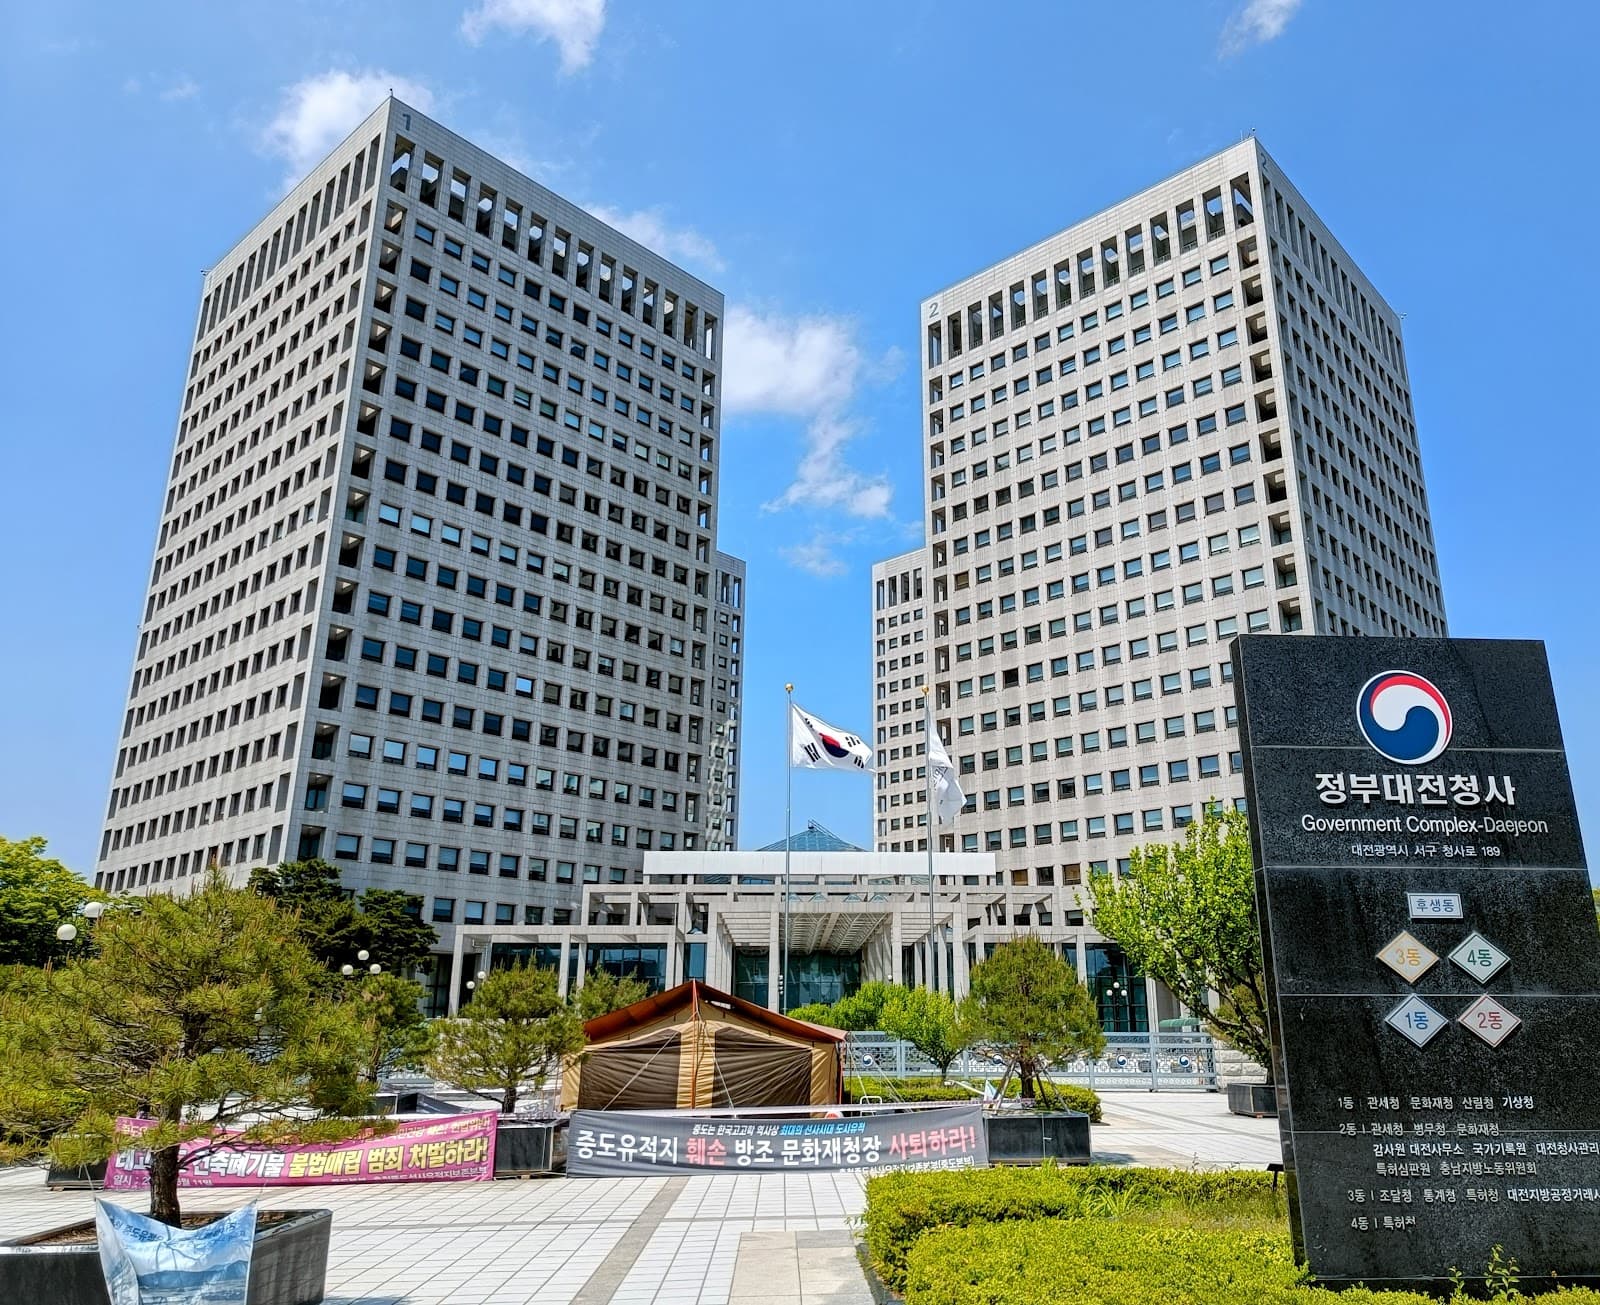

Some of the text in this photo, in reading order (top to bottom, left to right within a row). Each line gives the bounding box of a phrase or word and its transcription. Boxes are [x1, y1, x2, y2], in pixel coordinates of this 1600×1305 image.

[402, 113, 411, 131] 1
[929, 302, 939, 318] 2
[1315, 771, 1516, 806] 정부대전청사
[1301, 814, 1549, 836] Government Complex-Daejeon
[1351, 844, 1501, 857] 대전광역시 서구 청사로 189
[1416, 899, 1454, 913] 후생동
[1395, 948, 1422, 967] 3동
[1467, 949, 1493, 967] 4동
[1405, 1011, 1429, 1030] 1동
[1477, 1011, 1503, 1030] 2동
[1338, 1095, 1534, 1110] 1동 관세청 문화재청 산림청 기상청
[692, 1124, 715, 1136] 중도는
[1339, 1122, 1500, 1136] 2동 관세청 병무청 문화재청
[575, 1126, 976, 1167] 중도유적지 훼손 방조 문화재청장 사퇴하라!
[1373, 1143, 1406, 1157] 감사원
[1409, 1143, 1464, 1157] 대전사무소
[1472, 1142, 1527, 1156] 국가기록원
[288, 1150, 363, 1178] 불법매립
[367, 1145, 404, 1174] 범죄
[407, 1136, 488, 1169] 처벌하라!
[1376, 1161, 1537, 1176] 특허심판원 충남지방노동위원회
[1347, 1189, 1366, 1203] 3동
[1380, 1187, 1412, 1203] 조달청
[1423, 1188, 1456, 1203] 통계청
[1466, 1188, 1499, 1202] 특허청
[1350, 1217, 1369, 1231] 4동
